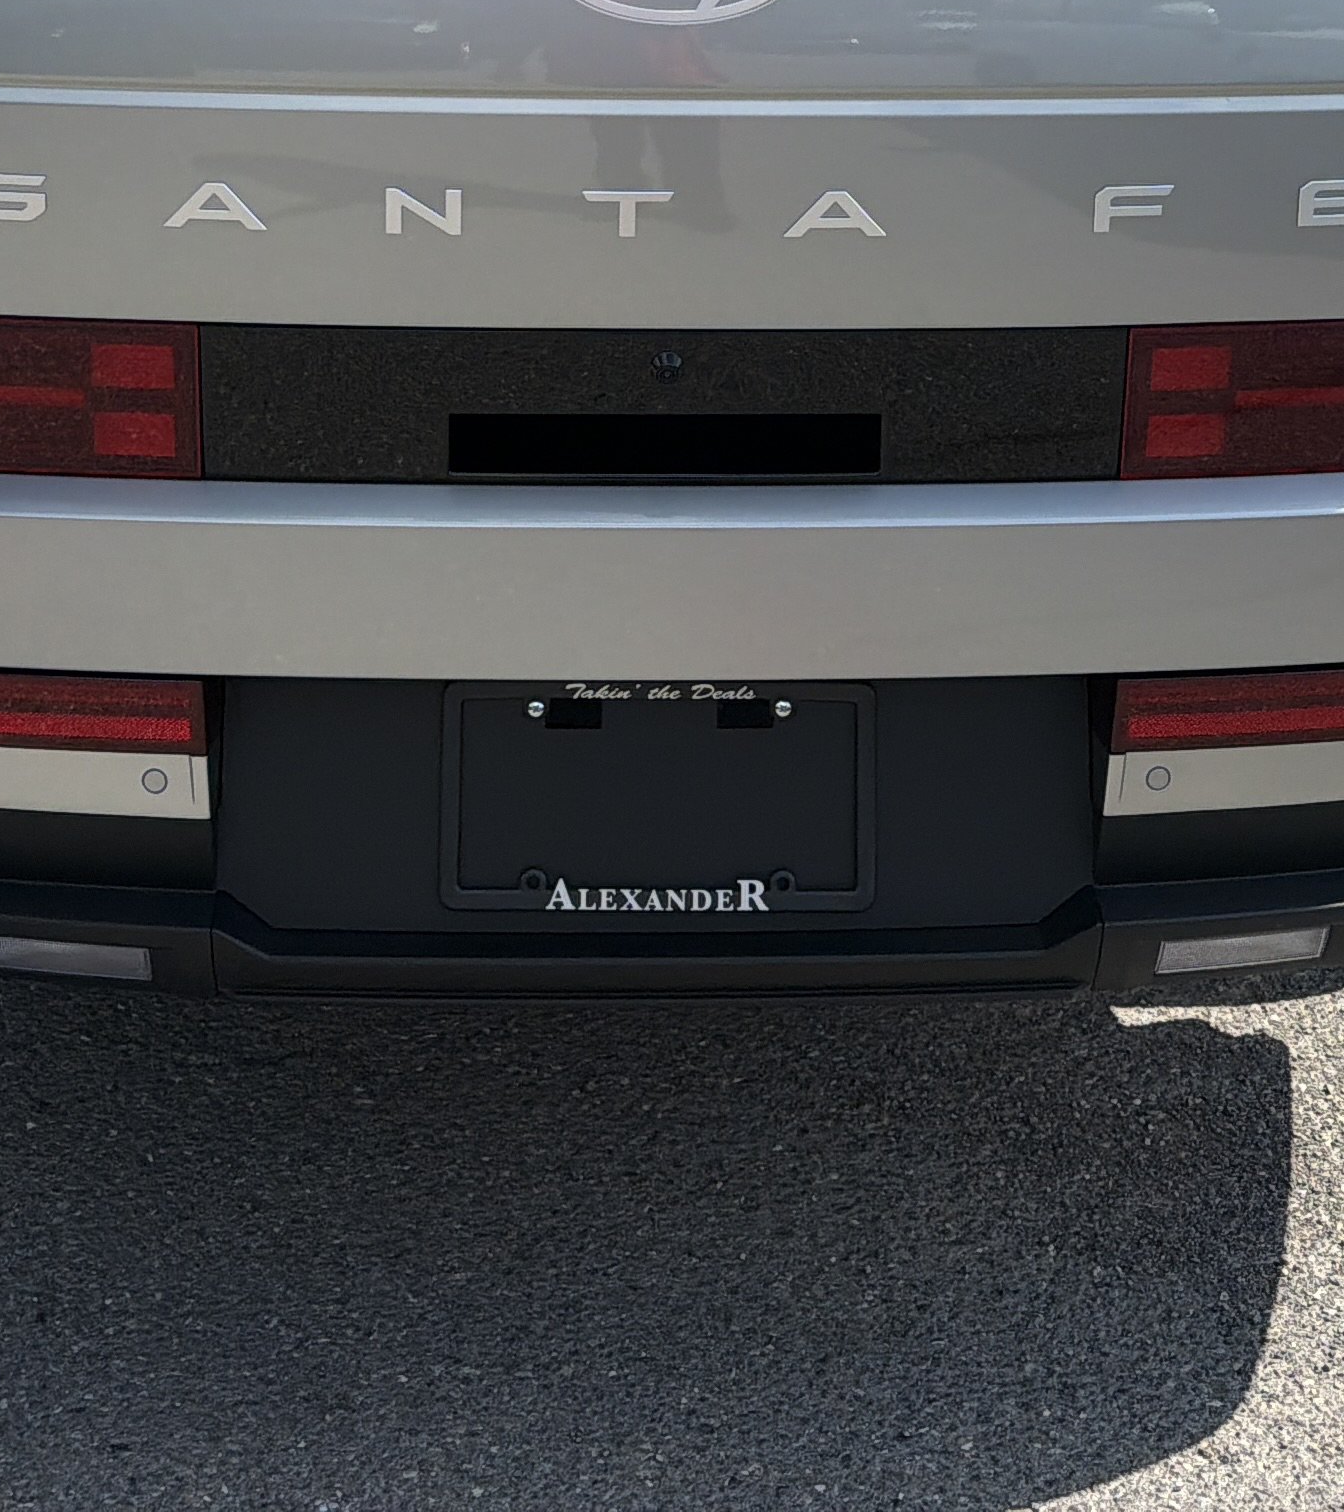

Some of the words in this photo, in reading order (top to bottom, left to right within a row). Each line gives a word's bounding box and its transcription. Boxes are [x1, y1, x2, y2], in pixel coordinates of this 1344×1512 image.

[564, 683, 642, 700] Takin'
[647, 684, 682, 700] the
[689, 683, 757, 700] Deals
[545, 877, 770, 912] ALEXANDER
